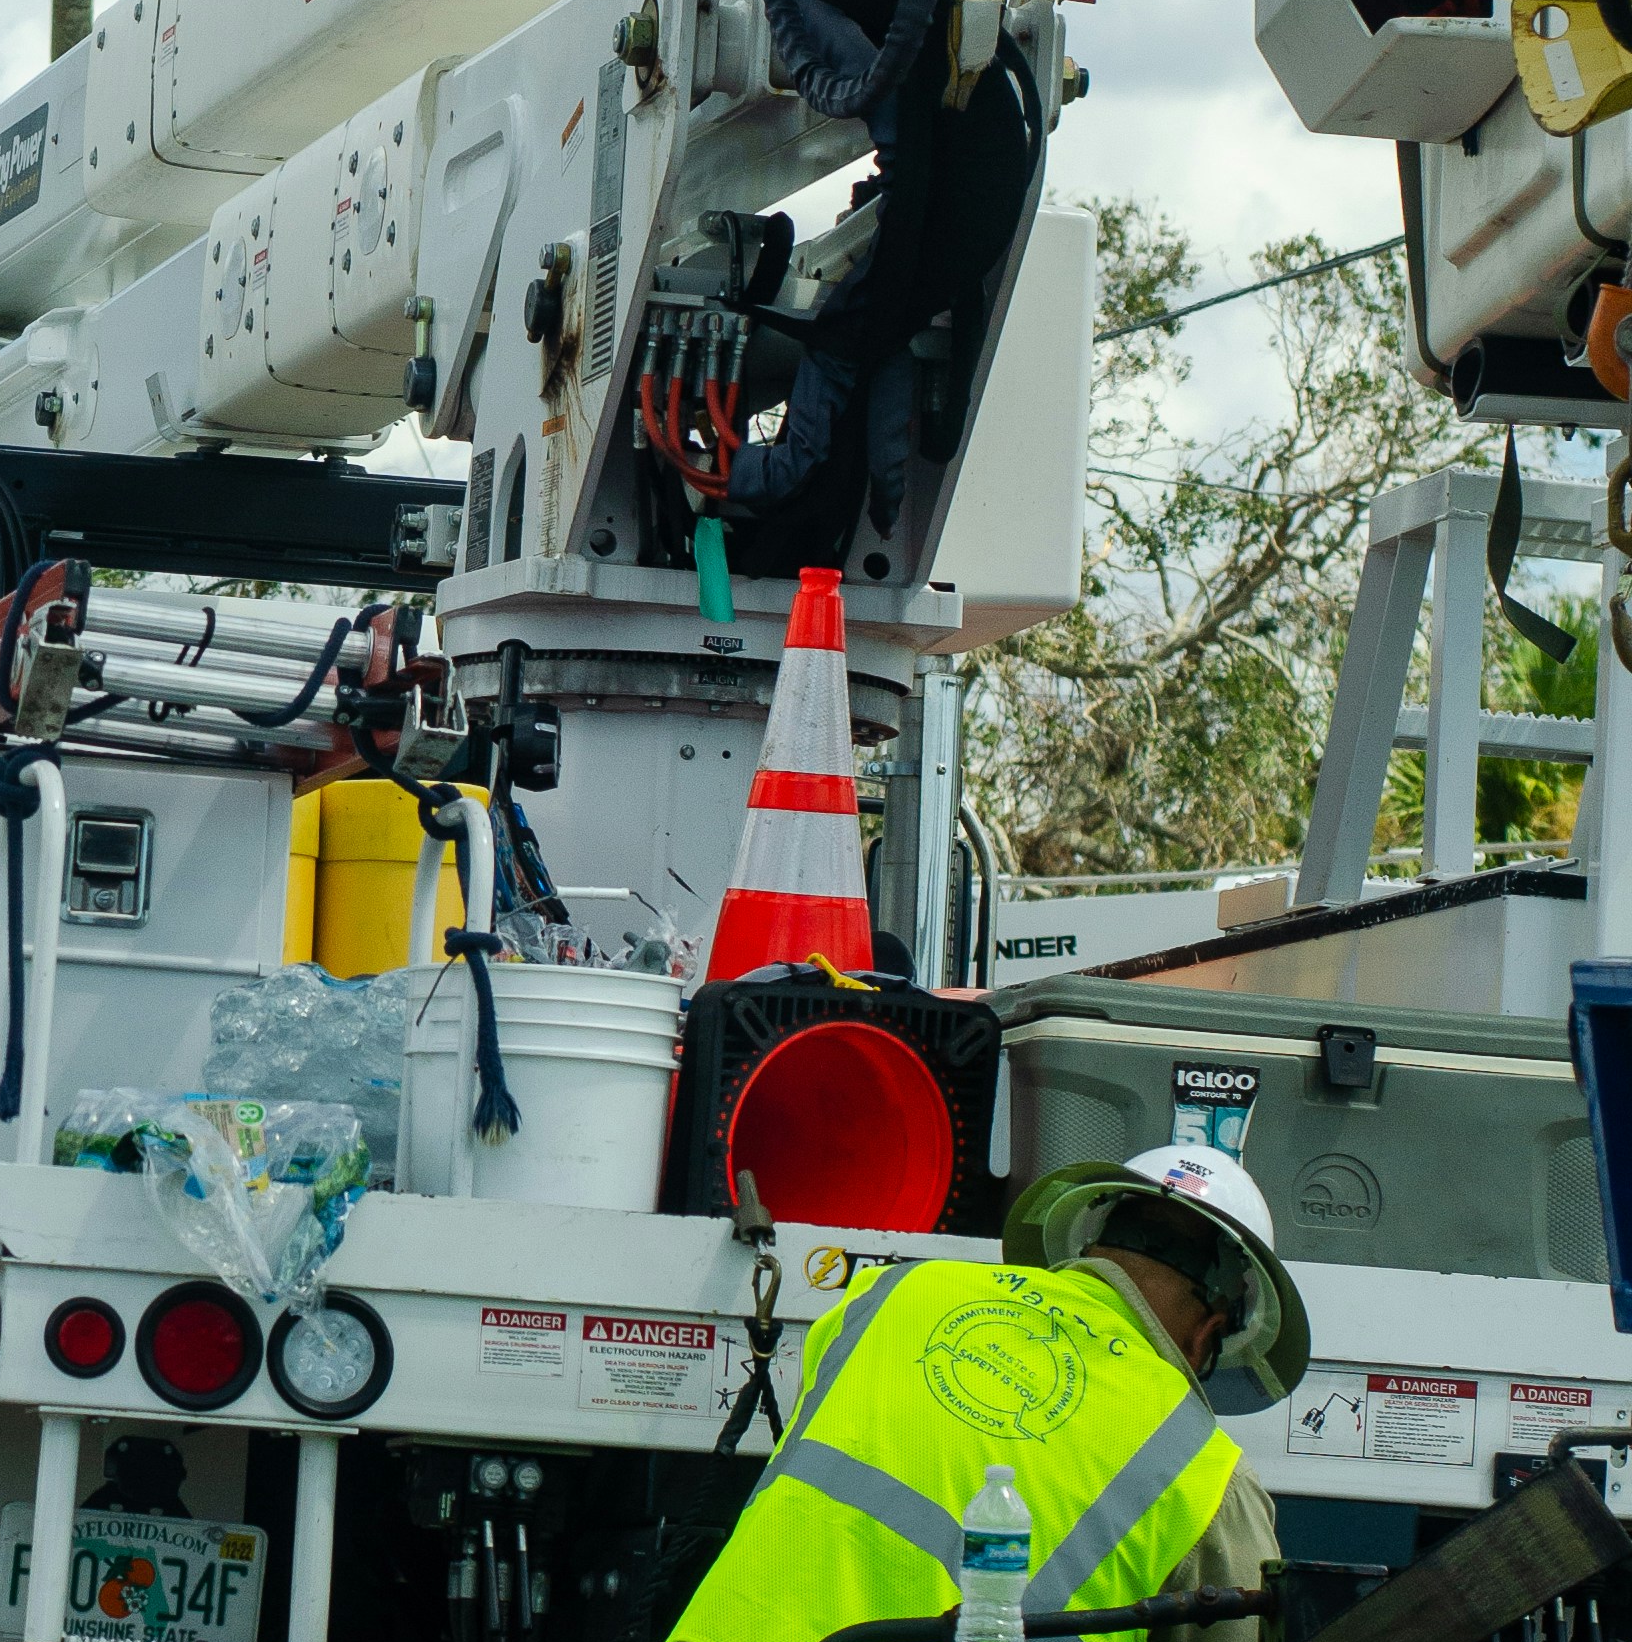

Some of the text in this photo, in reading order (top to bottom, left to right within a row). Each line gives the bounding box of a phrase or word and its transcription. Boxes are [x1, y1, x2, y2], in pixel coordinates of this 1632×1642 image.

[706, 636, 740, 649] ALIGN
[973, 934, 1077, 961] NDER
[1177, 1069, 1256, 1091] IGLOO
[1300, 1200, 1371, 1221] IGLOO
[499, 1312, 562, 1330] DANGER
[943, 1307, 1023, 1336] COMMITMENT
[611, 1322, 708, 1348] DANGER
[589, 1345, 707, 1362] ELECTROCUTION HAZARD
[958, 1348, 1002, 1377] SAFETY
[1000, 1373, 1012, 1385] IS
[1013, 1382, 1039, 1404] YOU
[1044, 1352, 1076, 1423] INVOLVEMENT
[1401, 1380, 1458, 1395] DANGER
[933, 1363, 1005, 1429] ACCOUNTABILITY
[1528, 1388, 1588, 1405] DANGER
[72, 1519, 209, 1557] YFLORIDA.COM
[63, 1617, 137, 1642] UNSHINE
